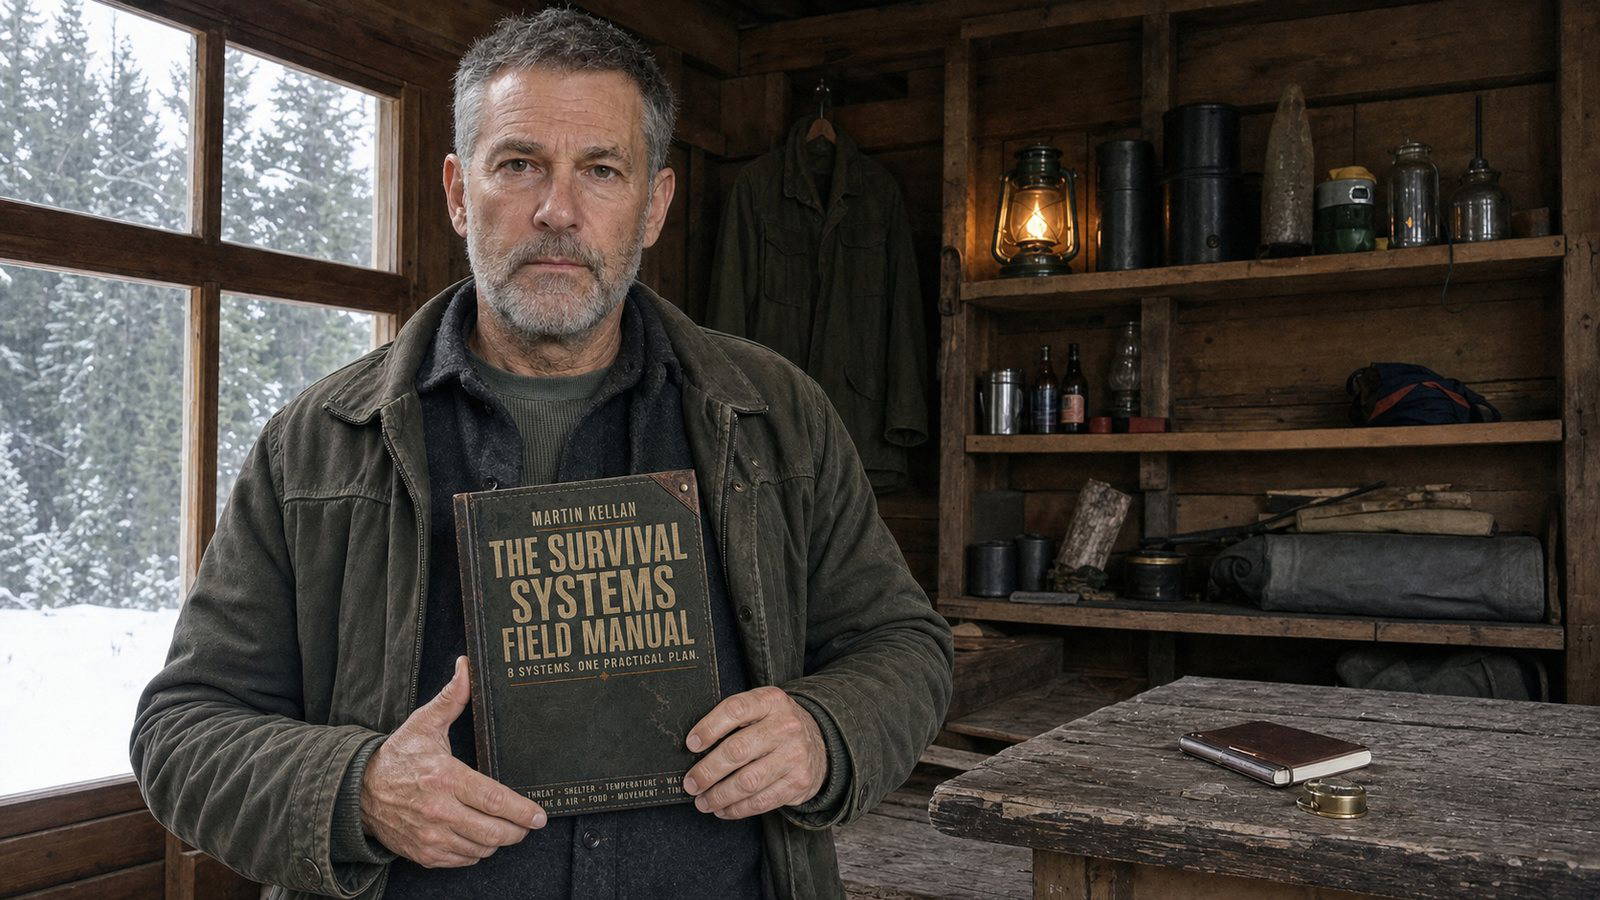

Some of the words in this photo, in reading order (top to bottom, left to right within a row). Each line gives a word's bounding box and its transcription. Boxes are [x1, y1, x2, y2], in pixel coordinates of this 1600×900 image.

[532, 504, 583, 526] MARTIN
[589, 502, 636, 521] KELLAN
[489, 536, 541, 578] THE
[547, 522, 687, 573] SURVIVAL
[510, 565, 676, 624] SYSTEMS
[501, 622, 571, 662] FIELD
[582, 609, 695, 655] MANUAL
[507, 668, 514, 678] 8
[518, 663, 574, 677] SYSTEMS.
[578, 660, 599, 672] ONE
[604, 654, 664, 668] PRACTICAL
[669, 651, 699, 662] PLAN.
[528, 789, 555, 799] THREAT
[564, 785, 596, 795] SHELTER
[605, 779, 657, 791] TEMPERATURE
[566, 797, 579, 805] AIR
[588, 794, 608, 803] FOOD
[618, 789, 658, 800] MOVEMENT
